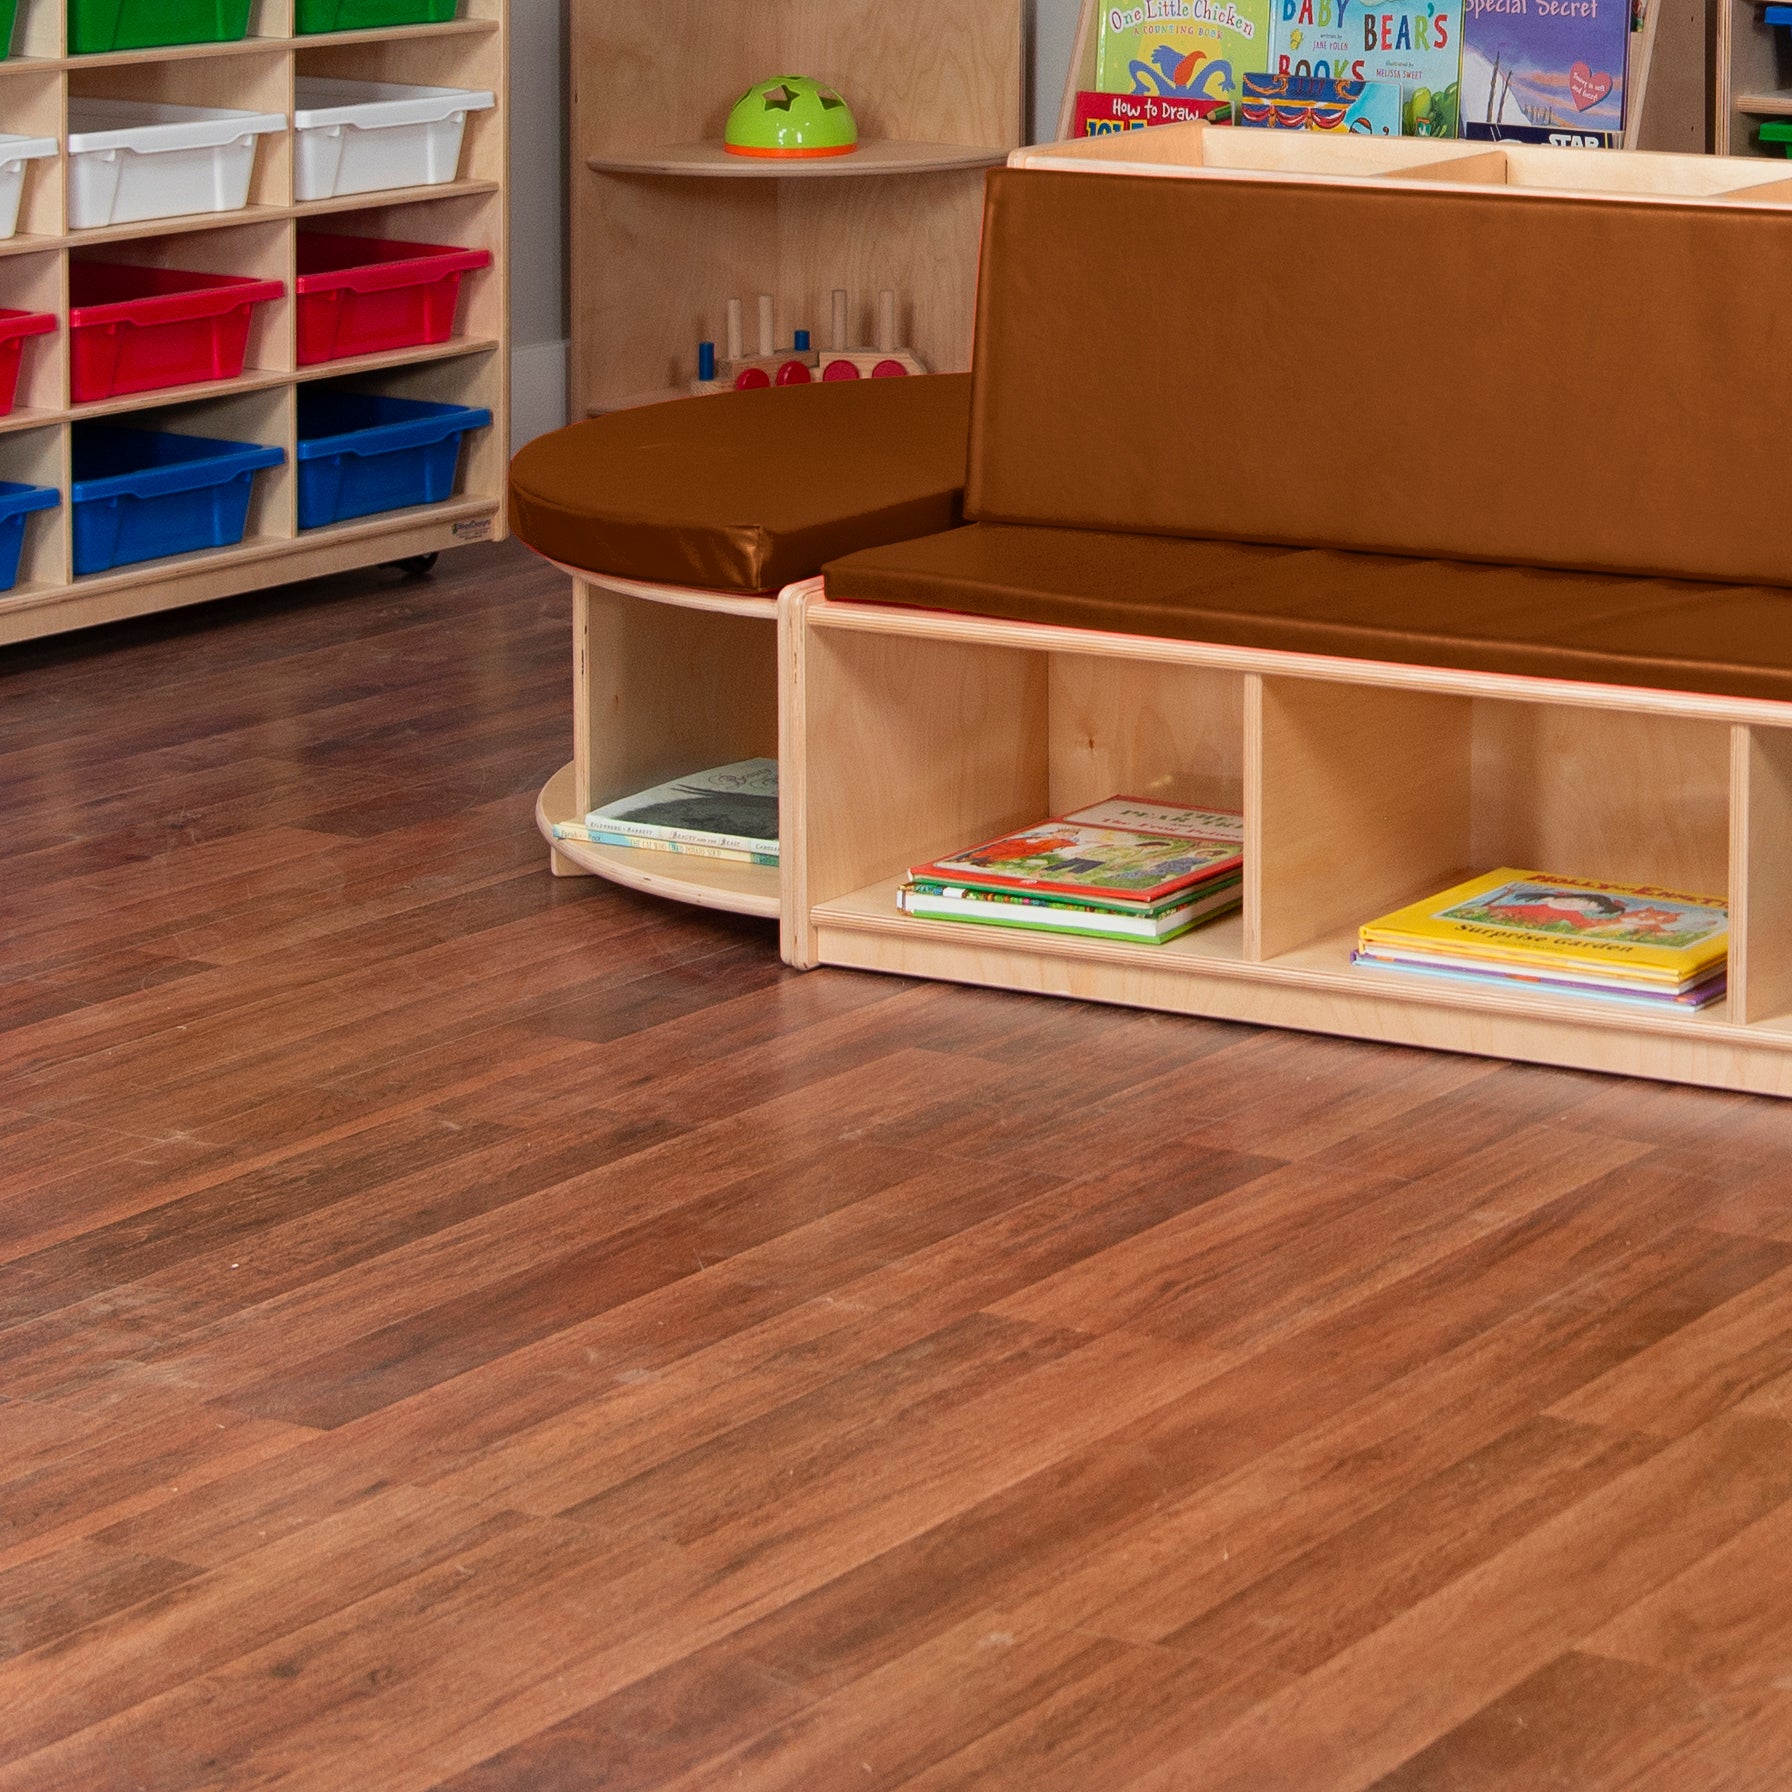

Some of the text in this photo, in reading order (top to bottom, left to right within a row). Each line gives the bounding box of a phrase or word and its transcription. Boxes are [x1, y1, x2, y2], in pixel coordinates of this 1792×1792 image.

[1111, 9, 1142, 30] One
[1364, 2, 1449, 51] BEAR'S
[1143, 25, 1194, 35] COUNTING
[1198, 29, 1224, 40] BOOK
[1113, 98, 1199, 121] How to Draw
[1454, 923, 1633, 952] Surprise Garden
